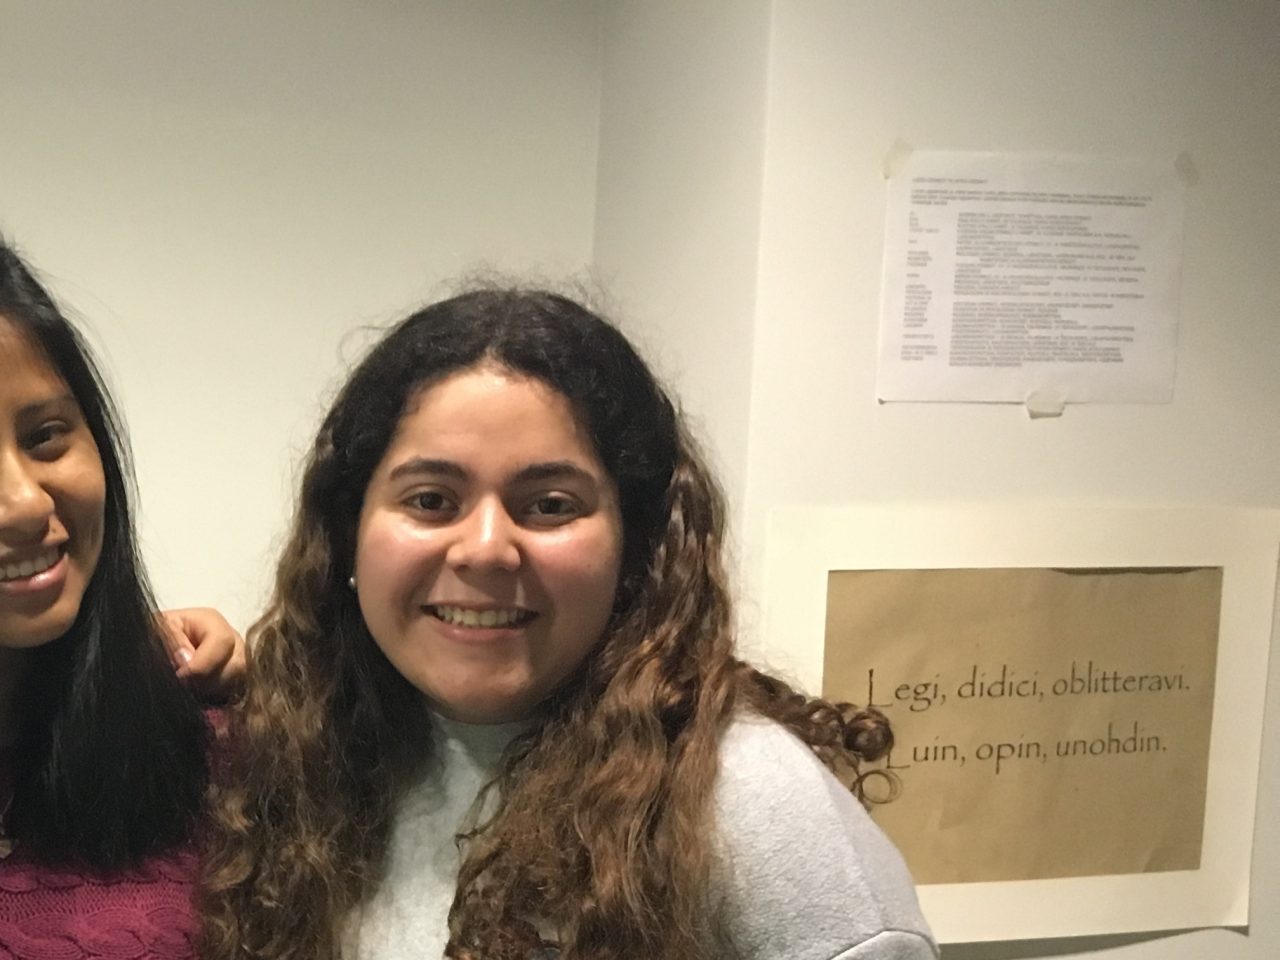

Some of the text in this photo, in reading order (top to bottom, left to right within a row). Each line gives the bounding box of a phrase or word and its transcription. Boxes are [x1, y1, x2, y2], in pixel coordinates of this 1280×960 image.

[866, 660, 1192, 713] Legi, didici, oblitteravi.
[975, 733, 1048, 775] opin,
[1055, 721, 1168, 757] unohdin.
